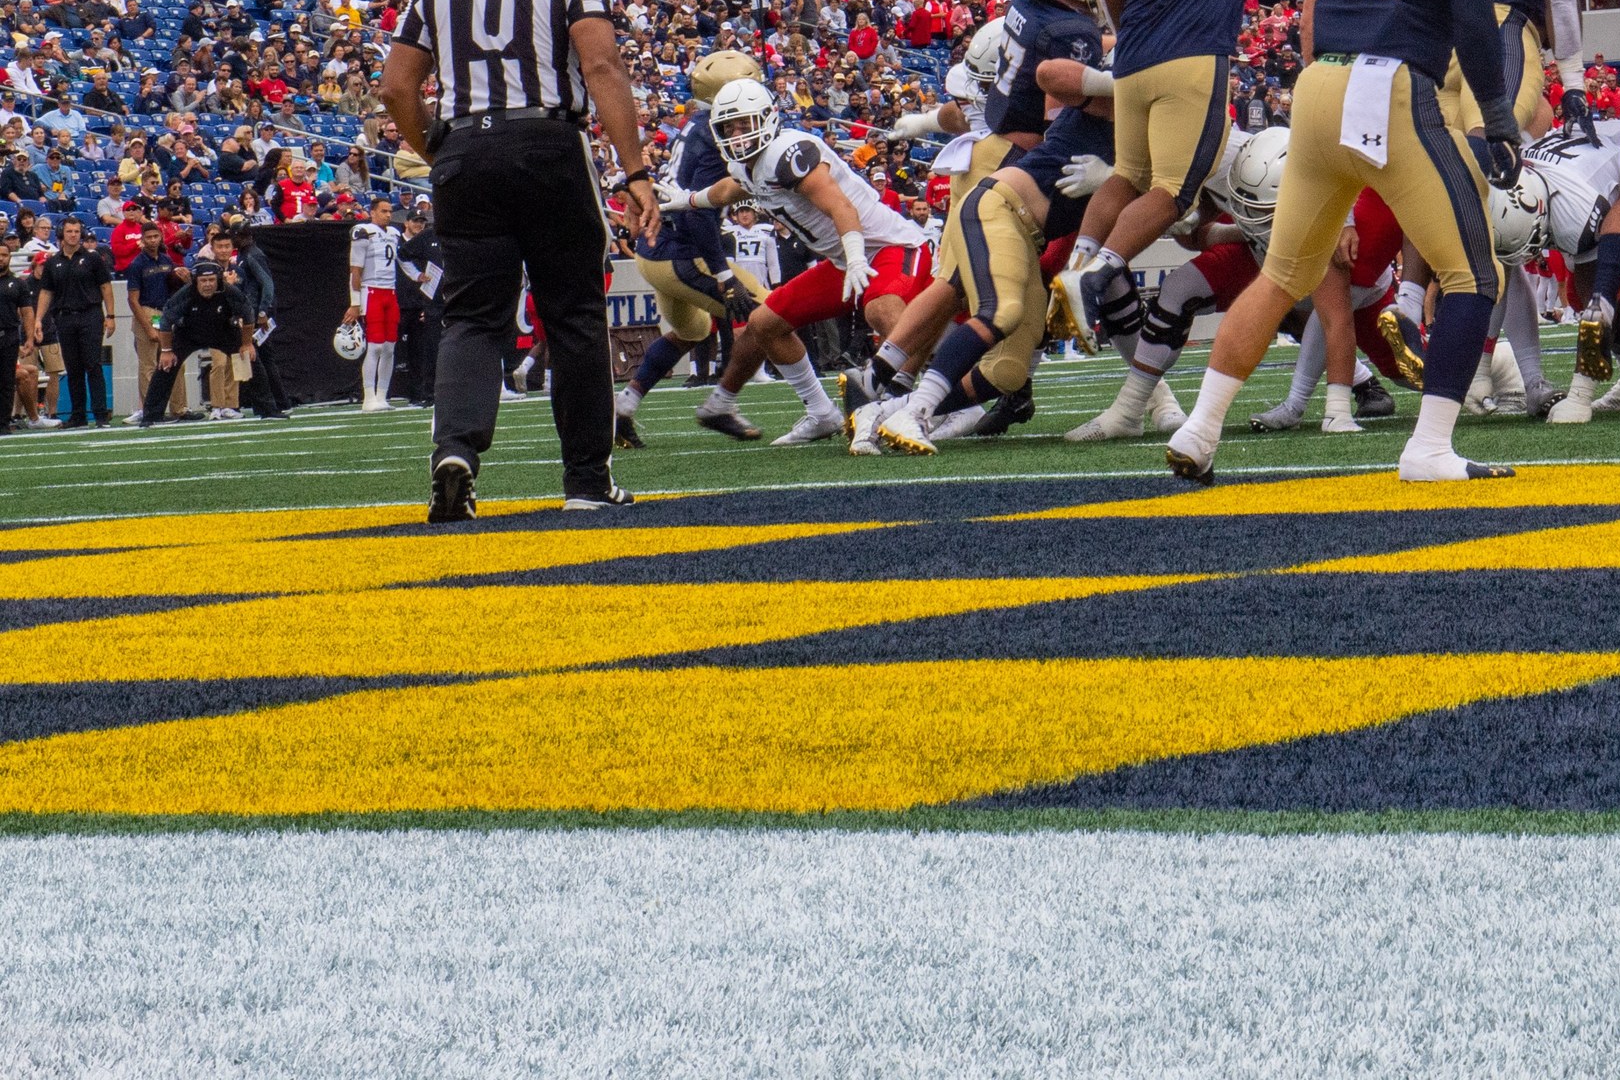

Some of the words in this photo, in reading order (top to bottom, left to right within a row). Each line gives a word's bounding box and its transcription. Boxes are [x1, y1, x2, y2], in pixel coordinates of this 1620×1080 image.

[481, 115, 492, 129] S
[385, 244, 394, 267] 9
[738, 241, 761, 256] 57
